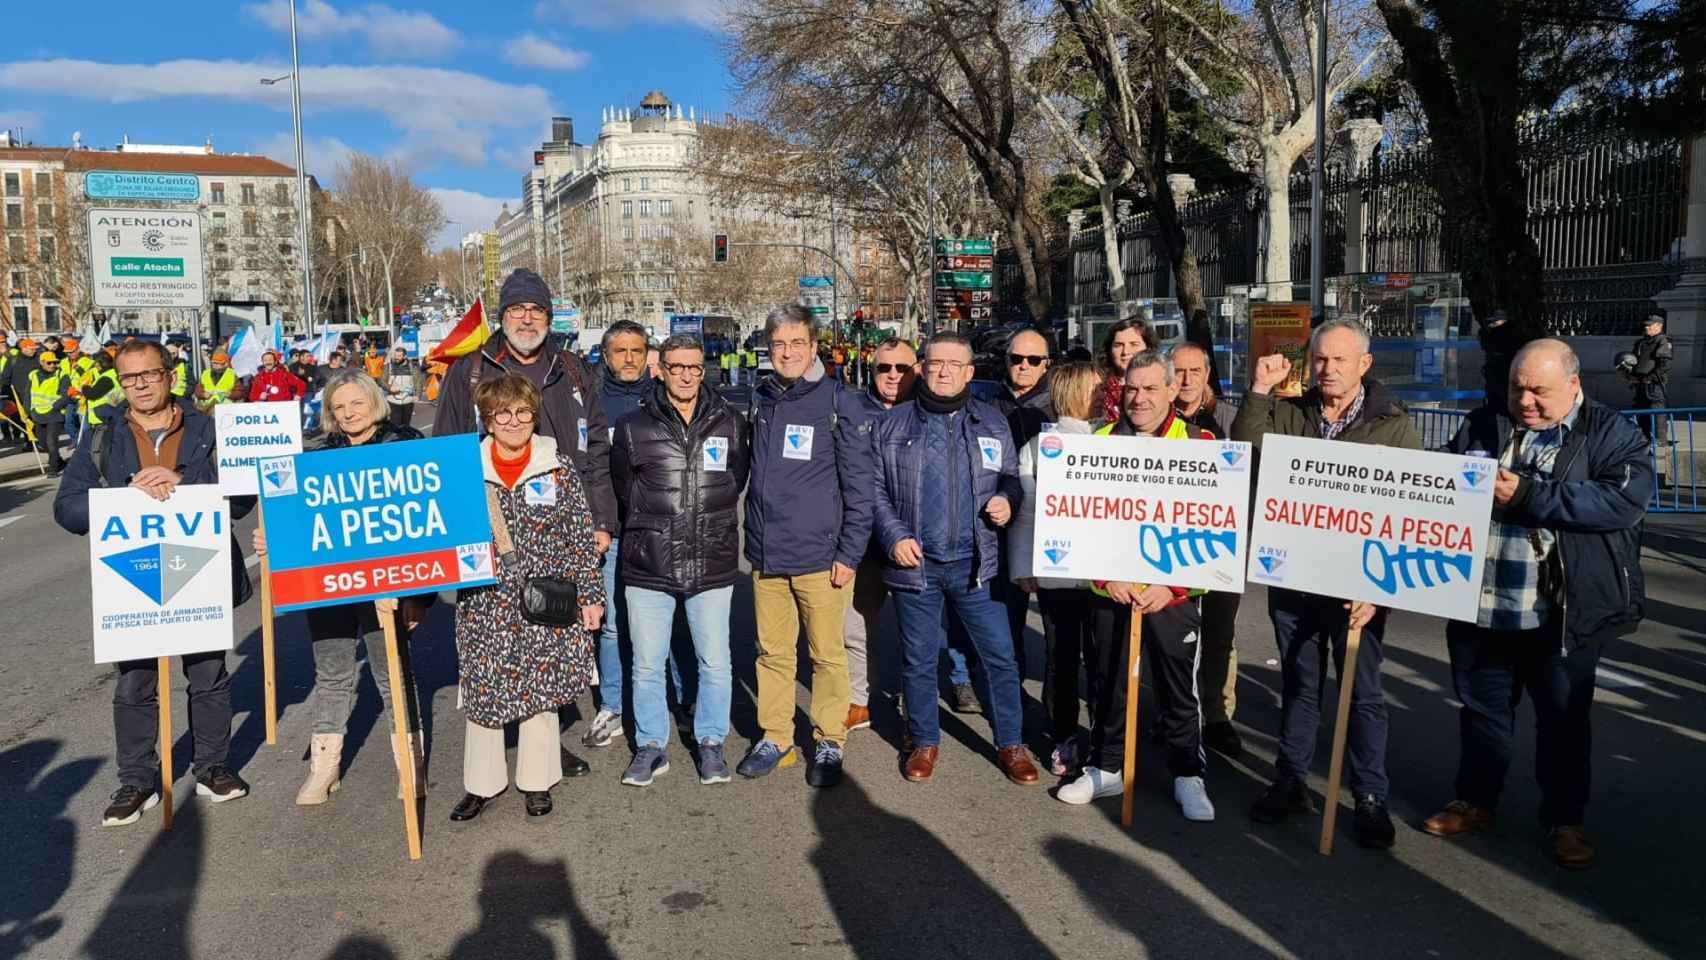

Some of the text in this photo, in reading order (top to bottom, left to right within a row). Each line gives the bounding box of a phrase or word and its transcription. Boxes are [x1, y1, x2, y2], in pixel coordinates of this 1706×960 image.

[115, 175, 196, 186] Distrito Centro
[97, 216, 193, 228] ATENCIÓN
[114, 263, 180, 272] calle Atocha
[140, 282, 198, 290] RESTRINGIDO
[235, 414, 279, 425] POR LA
[225, 433, 292, 447] SOBERANÍA
[220, 457, 257, 468] ALIME
[263, 459, 292, 471] ARVI
[1066, 454, 1076, 466] O
[1080, 455, 1140, 470] FUTURO
[1144, 458, 1164, 471] DA
[1168, 459, 1218, 474] PESCA
[1066, 468, 1218, 488] É O FUTURO DE VIGO E GALICIA
[1290, 458, 1457, 492] O FUTURO DA PESCA
[303, 462, 442, 508] SALVEMOS
[1288, 473, 1456, 506] É O FUTURO DE VIGO E GALICIA
[1045, 493, 1237, 529] SALVEMOS A PESCA
[100, 511, 221, 542] ARVI
[311, 498, 448, 552] A PESCA
[1264, 497, 1474, 553] SALVEMOS A PESCA
[134, 562, 159, 571] 1964
[323, 560, 446, 593] SOS PESCA
[102, 612, 159, 622] COOPERATIVA
[173, 605, 222, 616] ARMADORES
[102, 622, 112, 630] DE
[115, 620, 141, 629] PESCA
[160, 615, 191, 625] PUERTO
[193, 614, 202, 622] DE
[205, 612, 224, 620] VIGO
